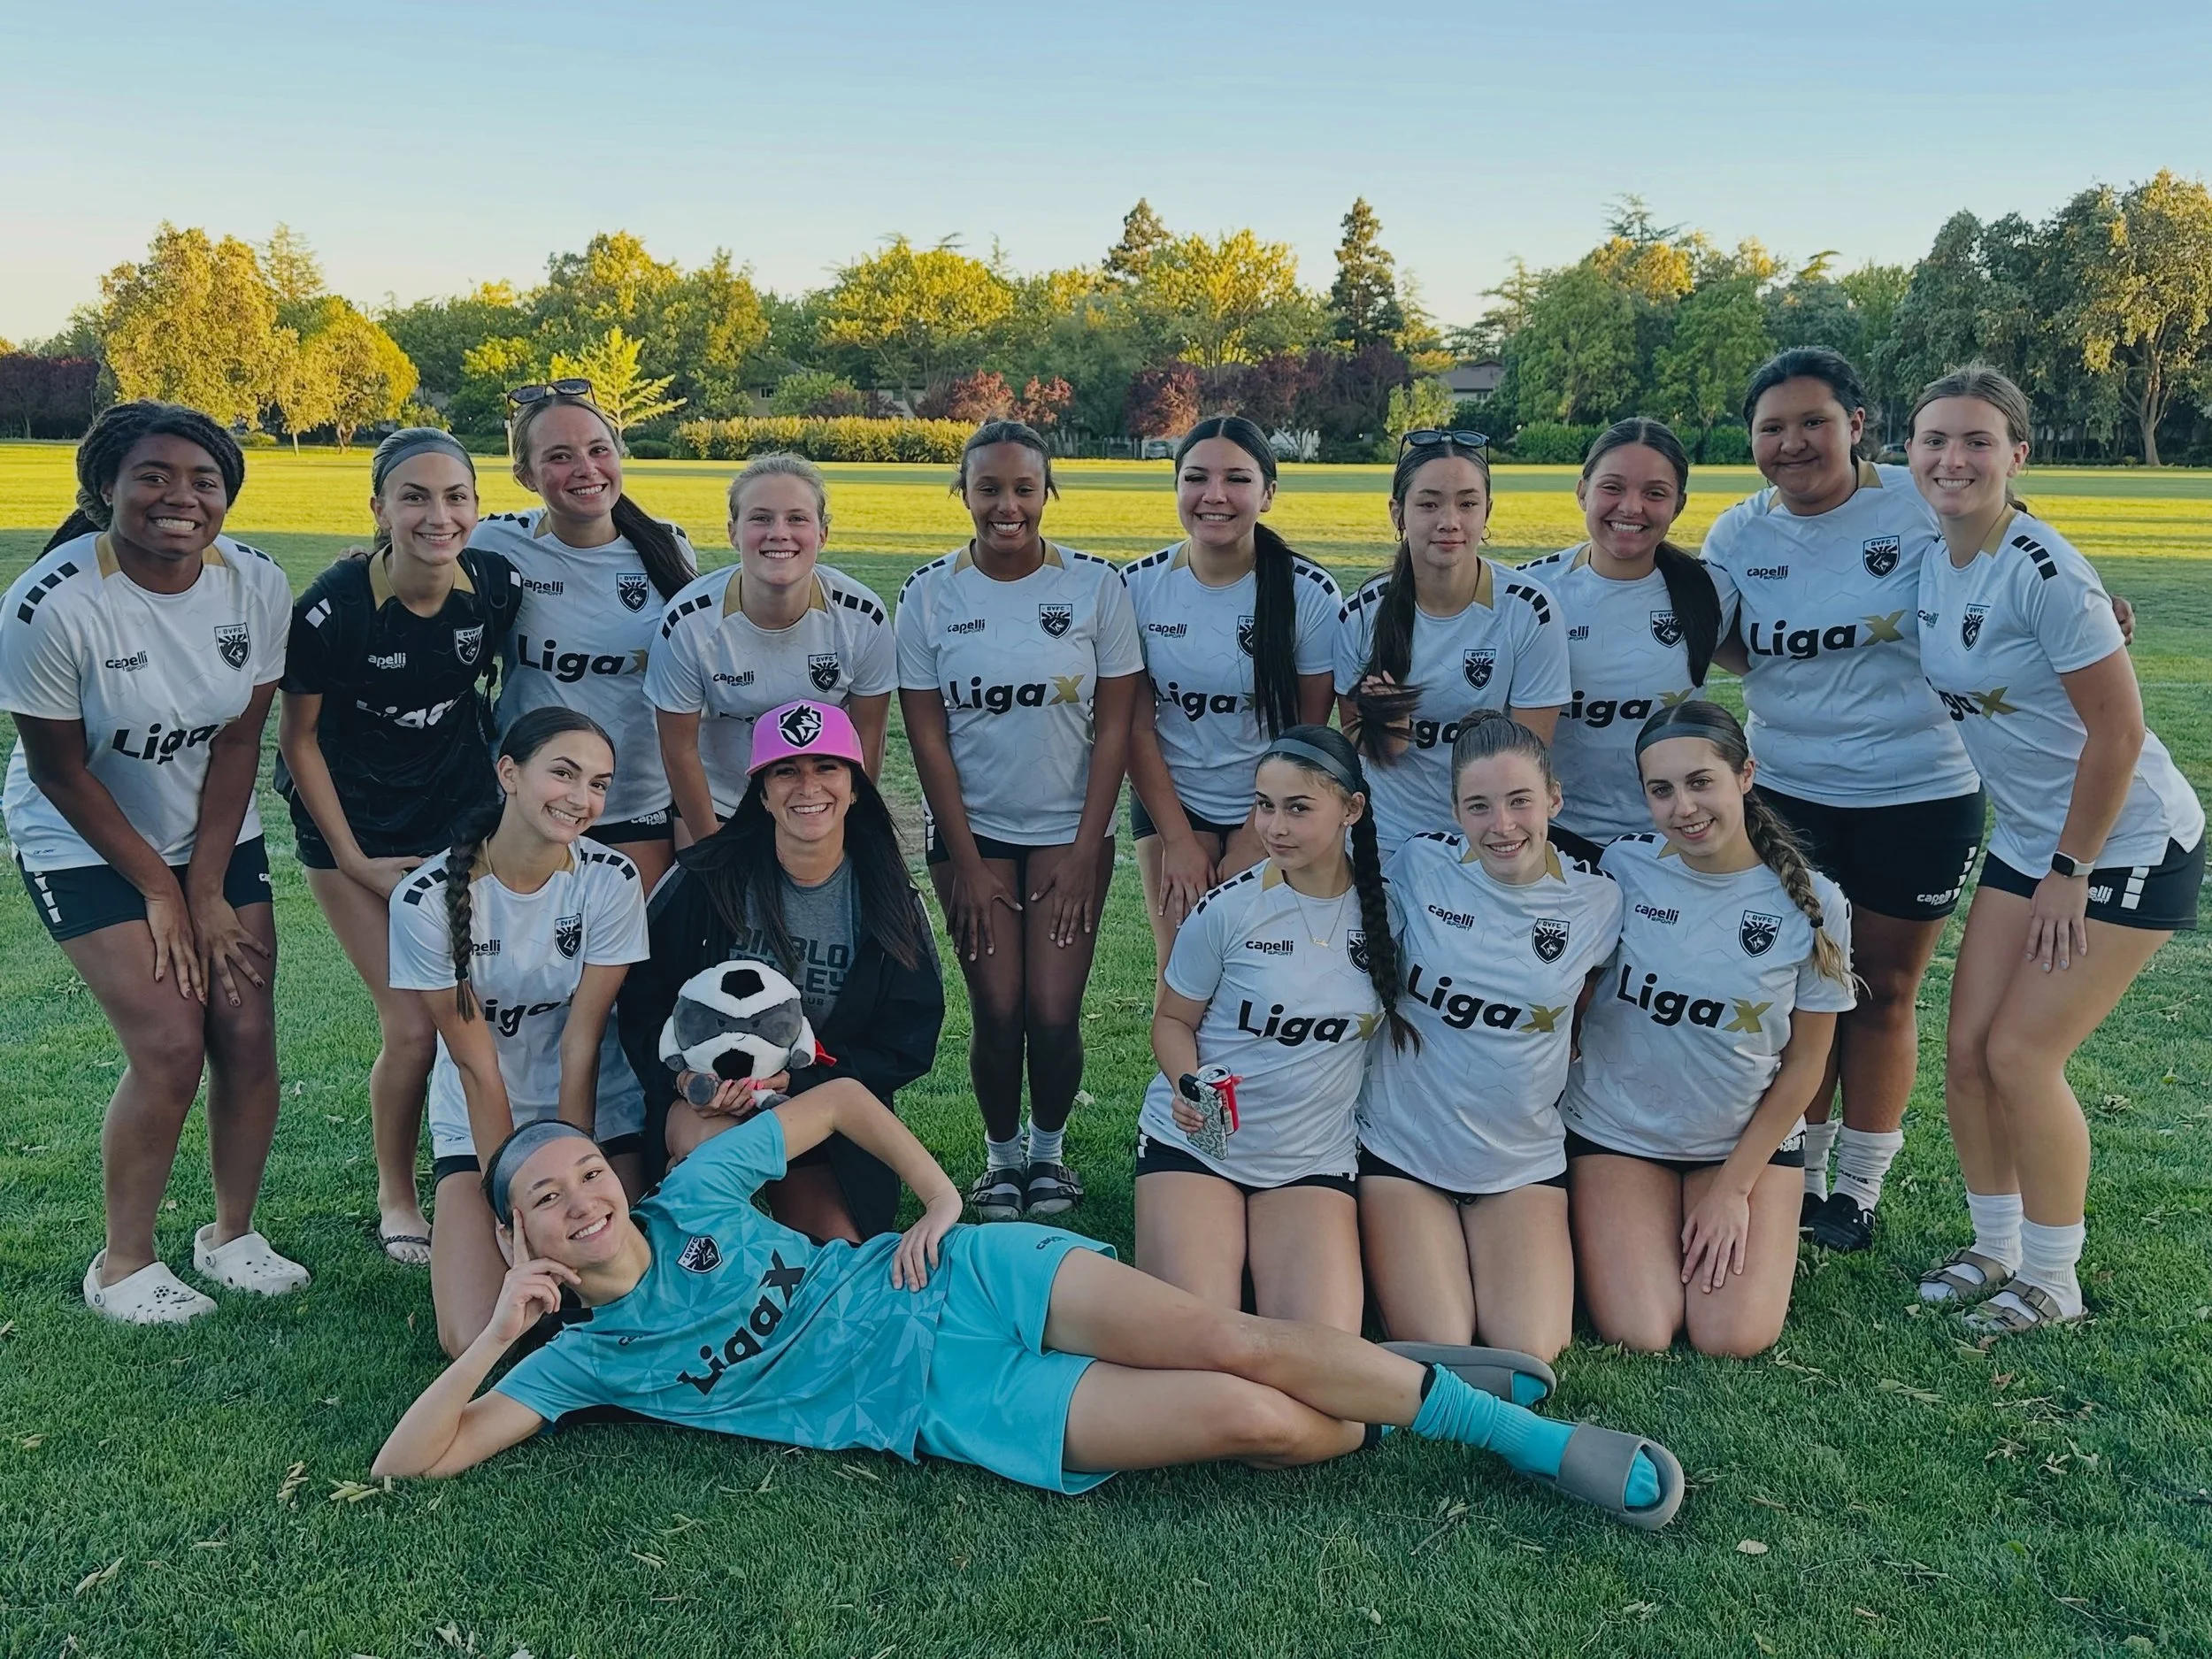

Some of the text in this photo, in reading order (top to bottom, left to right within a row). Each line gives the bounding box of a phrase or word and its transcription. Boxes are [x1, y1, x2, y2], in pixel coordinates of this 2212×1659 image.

[1747, 565, 1789, 579] capelli
[523, 580, 564, 592] apelli
[947, 618, 986, 634] capelli
[1148, 623, 1187, 635] capelli
[1569, 626, 1589, 637] elli
[1749, 609, 1908, 660] LigaX
[105, 650, 148, 671] capelli
[368, 652, 406, 667] apelli
[713, 671, 754, 685] capelli
[949, 674, 1086, 715] LigaX
[111, 720, 226, 765] Liga
[2088, 885, 2114, 902] elli
[1427, 904, 1475, 927] capelli
[1634, 904, 1679, 922] capelli
[1752, 914, 1773, 924] DVFC
[472, 940, 501, 956] pelli
[1245, 940, 1294, 953] capelli
[1408, 964, 1569, 1034] LigaX
[1617, 963, 1775, 1034] LigaX
